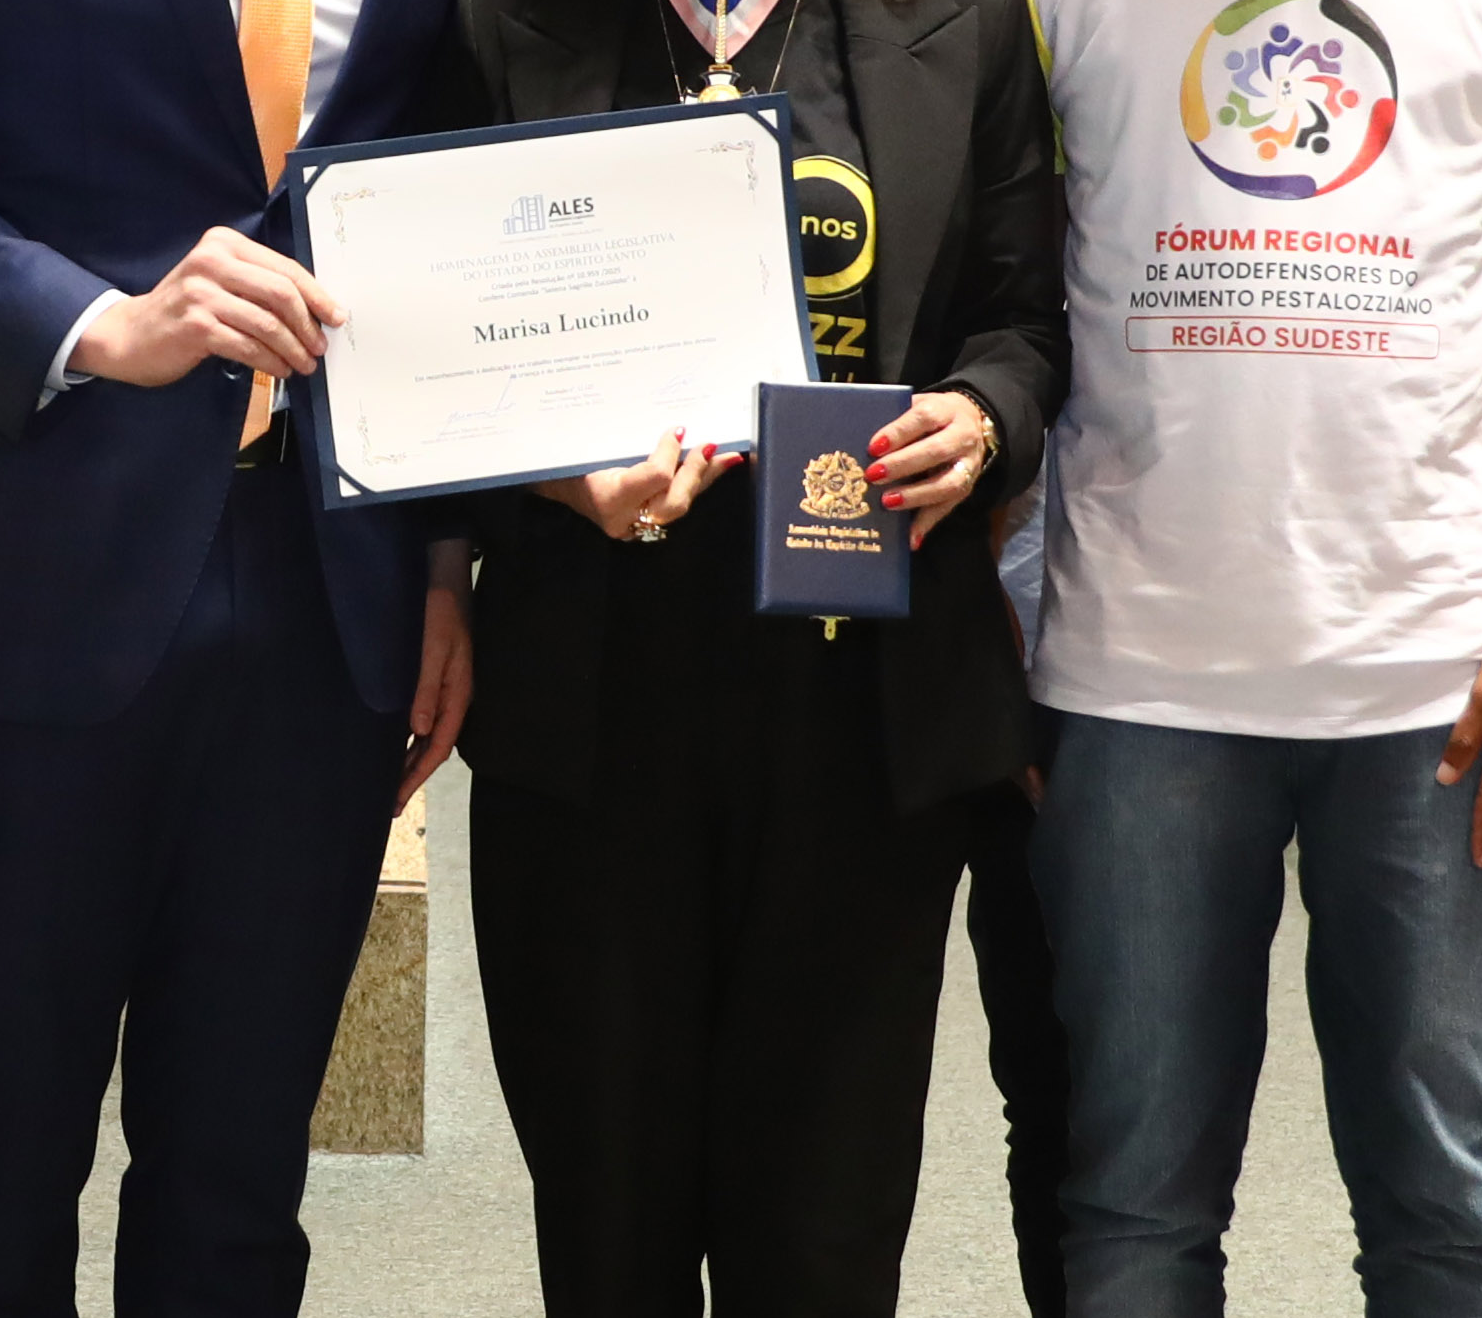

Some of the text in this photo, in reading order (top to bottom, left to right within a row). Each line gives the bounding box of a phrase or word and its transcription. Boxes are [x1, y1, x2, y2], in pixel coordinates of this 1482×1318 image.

[548, 197, 595, 216] ALES
[430, 253, 510, 273] HOMENAGEM
[513, 251, 530, 262] DA
[534, 242, 601, 259] ASSEMBLEIA
[604, 232, 676, 250] LEGISLATIVA
[1155, 223, 1414, 260] FÓRUM REGIONAL
[463, 271, 481, 281] DO
[484, 264, 529, 279] ESTADO
[532, 261, 551, 272] DO
[606, 248, 647, 262] SANTO
[1146, 262, 1419, 287] DE AUTODEFENSORES DO
[1130, 290, 1433, 315] MOVIMENTO PESTALOZZIANO
[473, 304, 649, 344] Marisa Lucindo
[1172, 321, 1390, 352] REGIÃO SUDESTE
